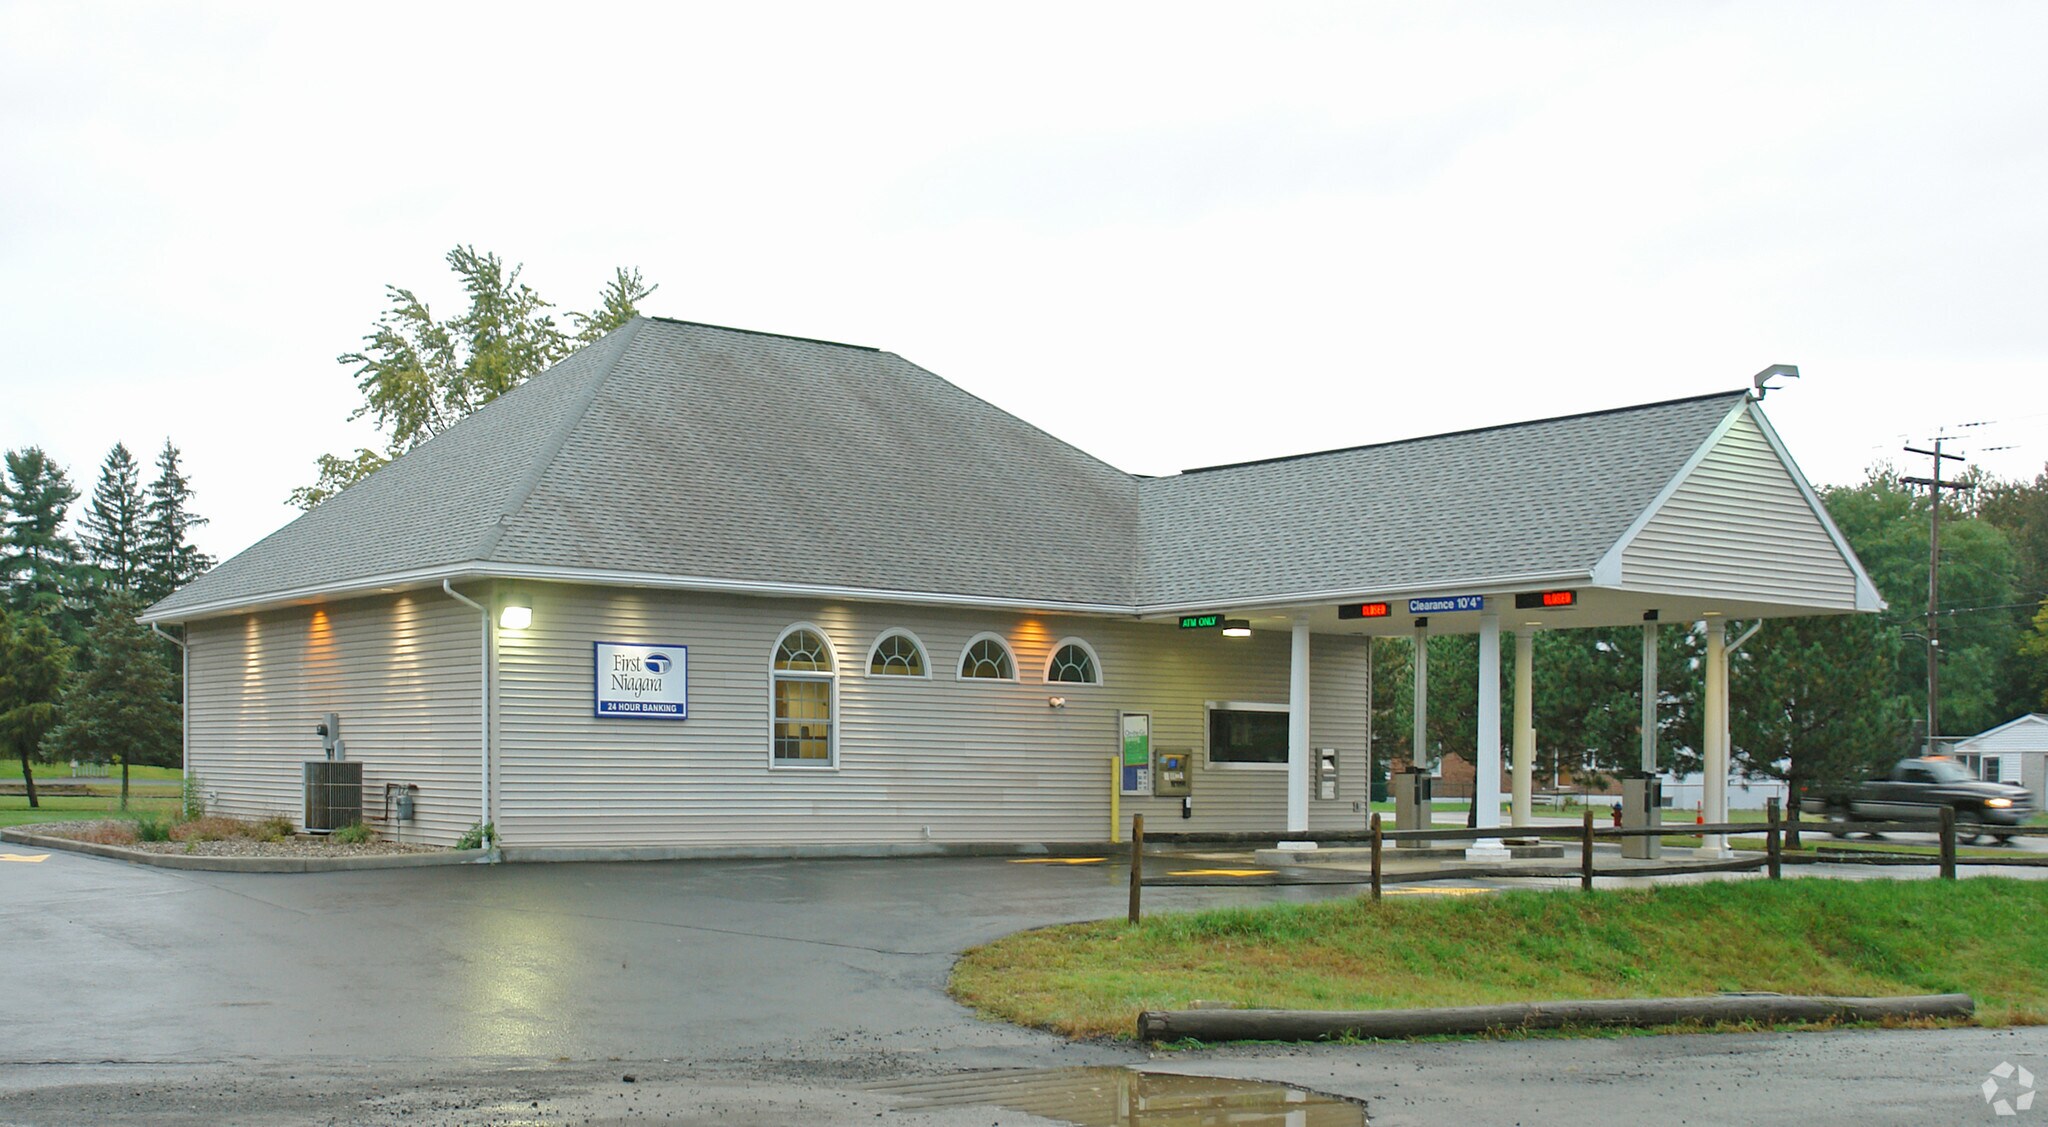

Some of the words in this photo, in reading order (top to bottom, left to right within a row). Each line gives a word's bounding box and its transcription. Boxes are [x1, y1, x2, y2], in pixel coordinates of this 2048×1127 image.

[1362, 603, 1386, 617] CLOSED
[1410, 600, 1455, 611] Clearance
[1457, 596, 1482, 609] 10'4"
[1182, 618, 1197, 628] ATM
[1198, 616, 1217, 627] ONLY
[613, 654, 642, 672] First
[611, 674, 662, 698] Niagara
[607, 702, 618, 711] 24
[618, 703, 641, 712] HOUR
[642, 703, 677, 713] BANKING
